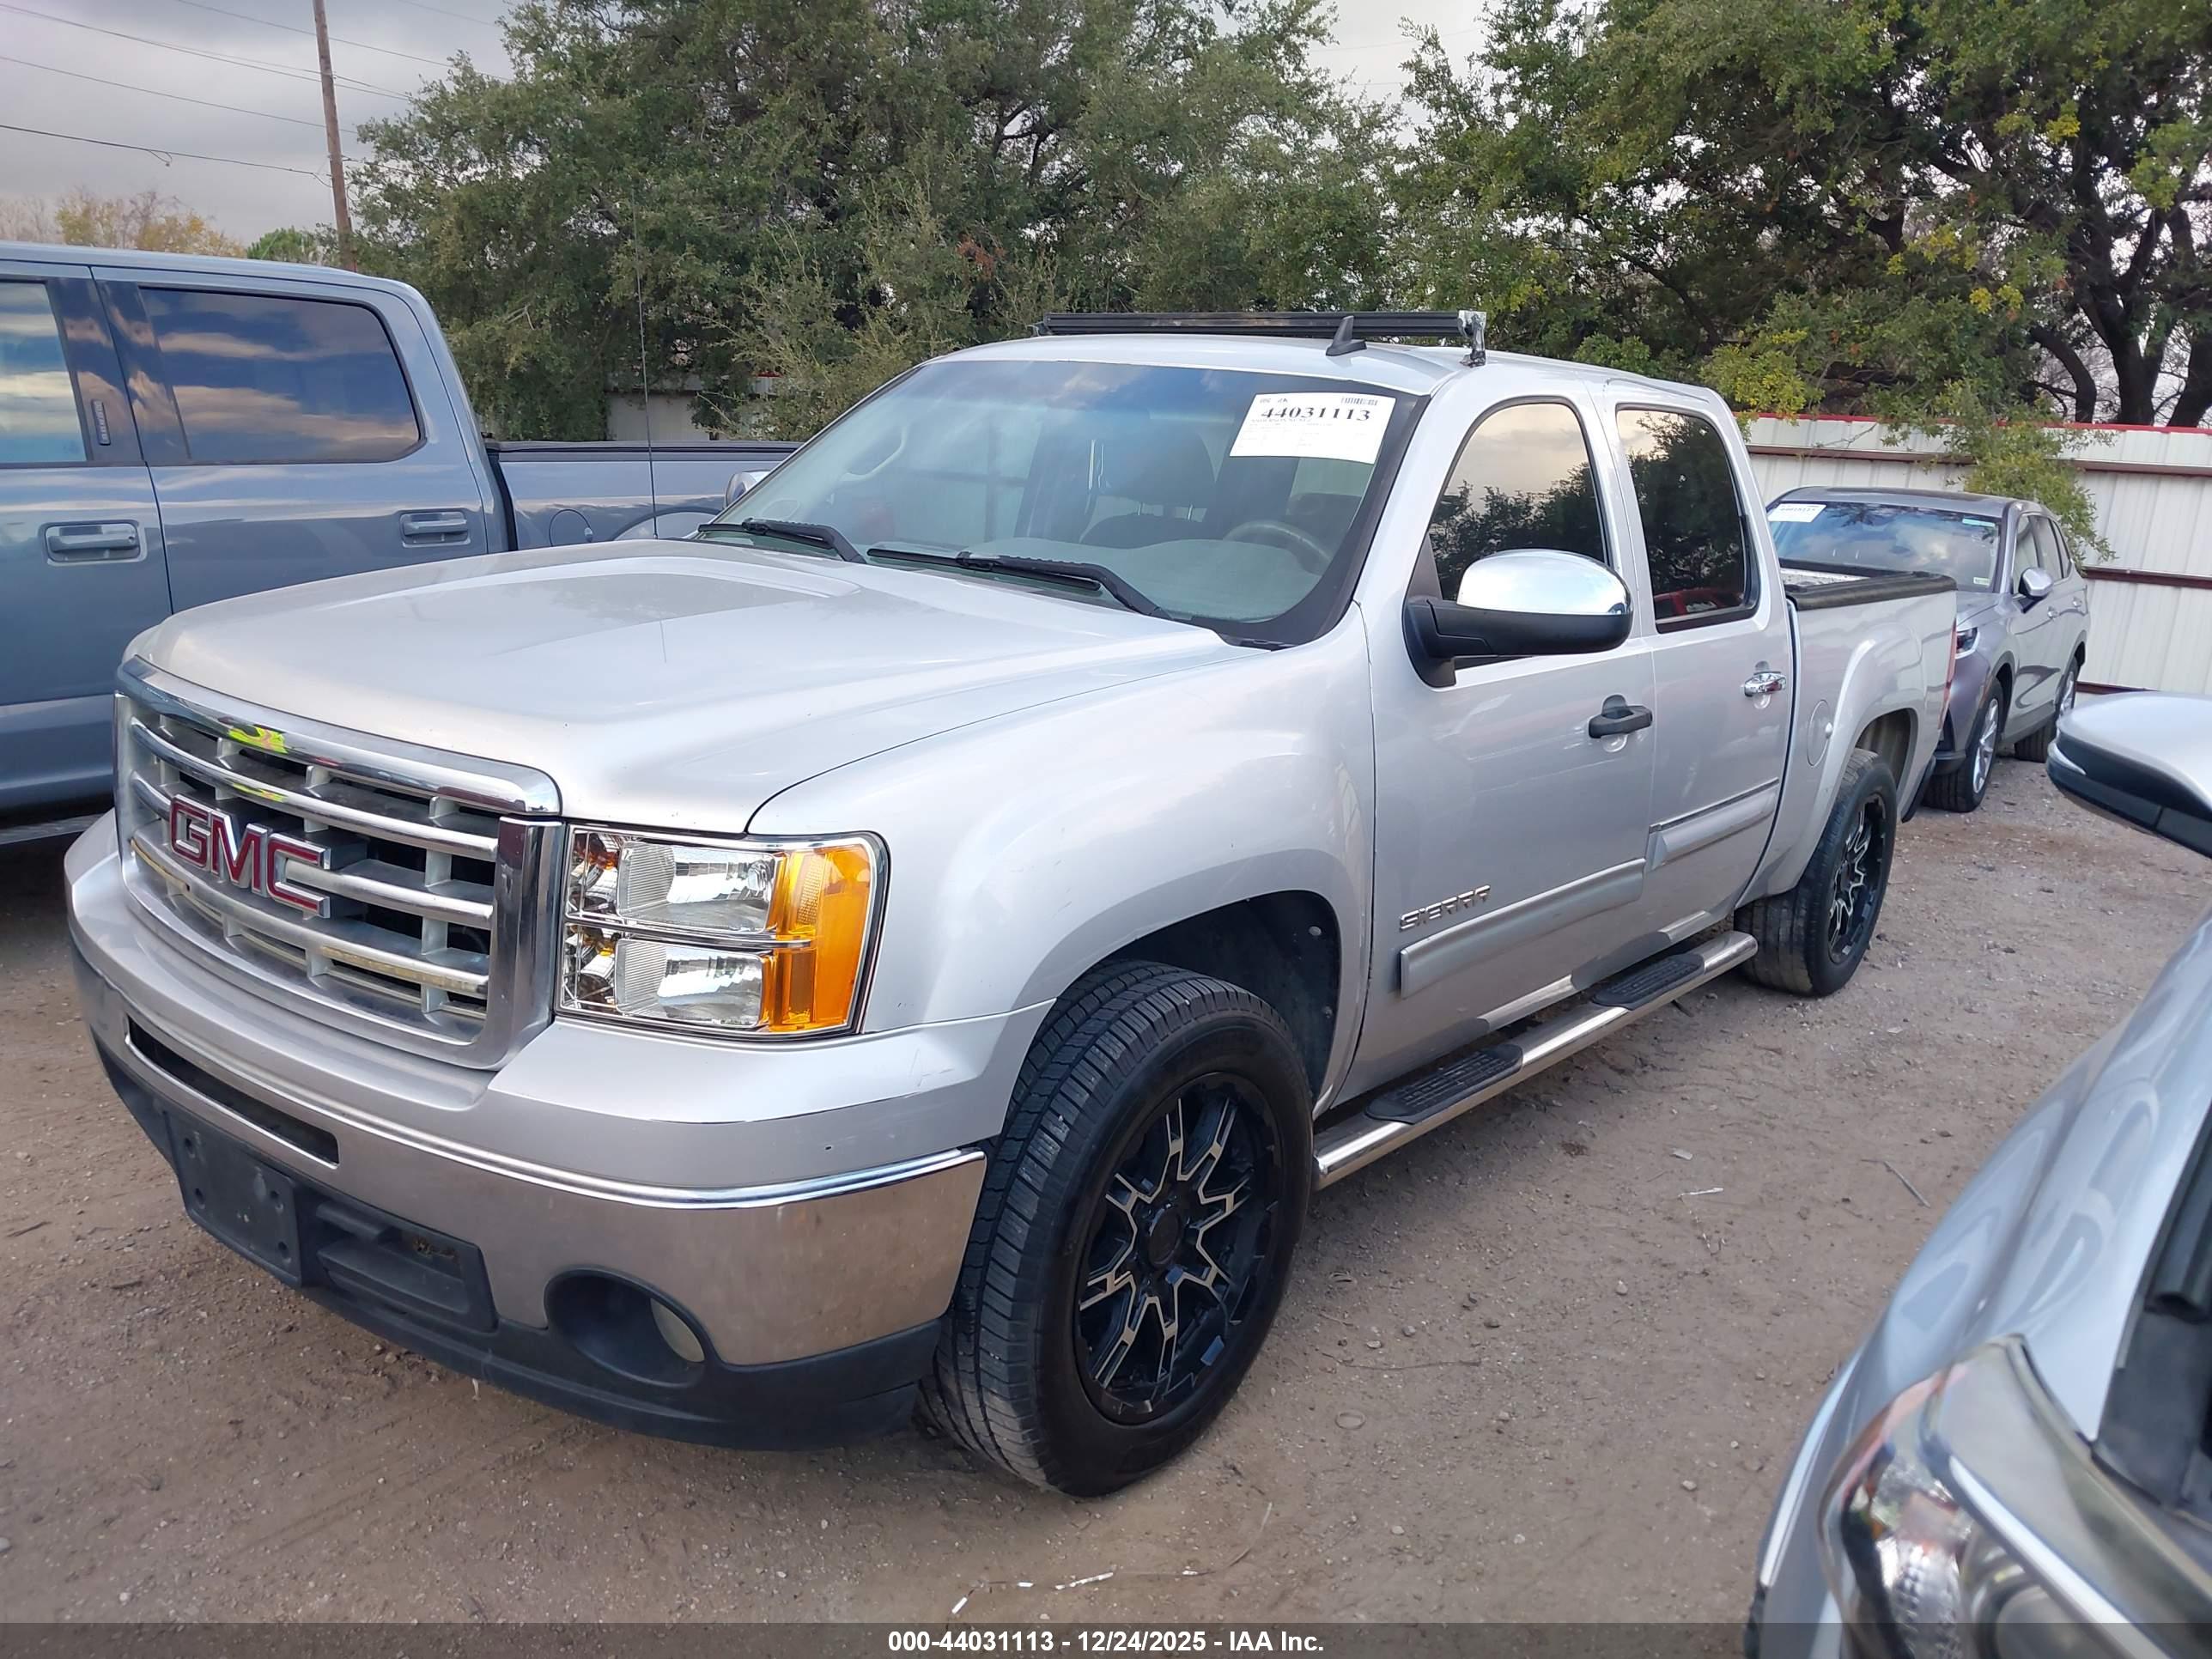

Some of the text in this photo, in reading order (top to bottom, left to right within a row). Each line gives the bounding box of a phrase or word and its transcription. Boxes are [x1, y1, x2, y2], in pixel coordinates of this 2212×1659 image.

[1261, 406, 1370, 422] 44031113
[170, 793, 331, 920] GMC
[1399, 884, 1492, 932] SIERRA
